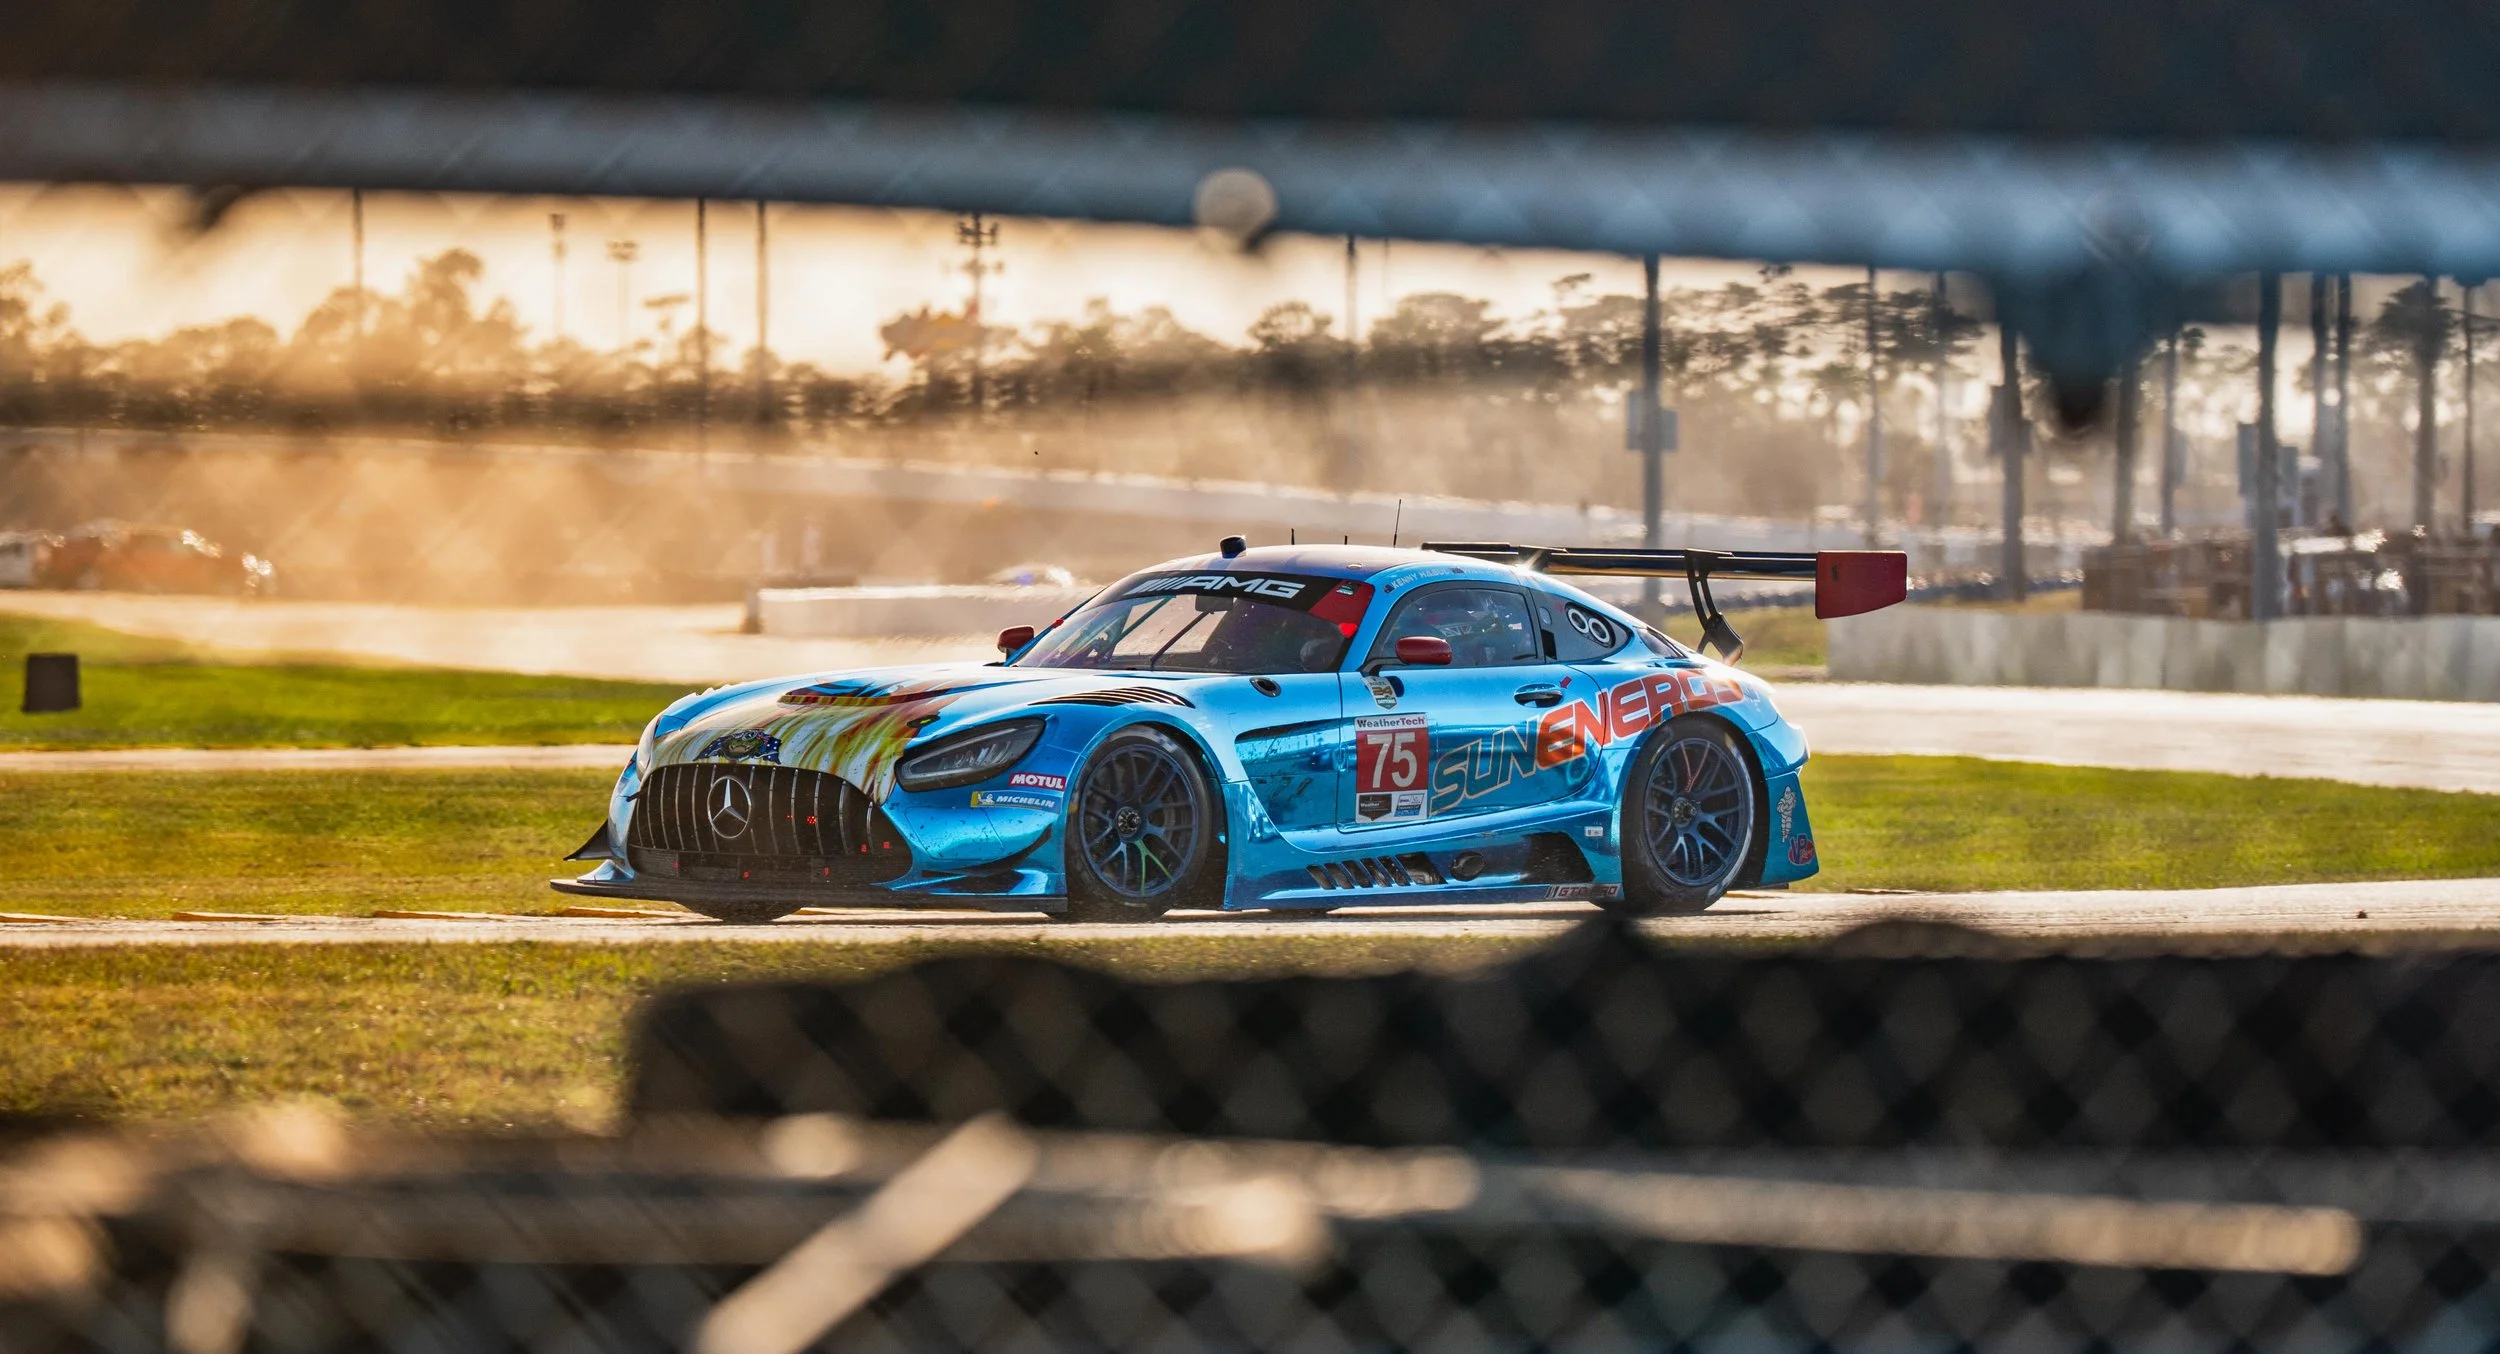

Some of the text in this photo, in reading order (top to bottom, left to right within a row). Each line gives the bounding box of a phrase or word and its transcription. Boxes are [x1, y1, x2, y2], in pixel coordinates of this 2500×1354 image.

[1173, 576, 1305, 599] AMG
[1391, 573, 1418, 589] KENNY
[1372, 686, 1393, 696] 24
[1356, 717, 1425, 728] WeatherTech
[1366, 731, 1418, 788] 75
[1011, 774, 1063, 788] MOTUL
[997, 795, 1055, 808] MICHELIN
